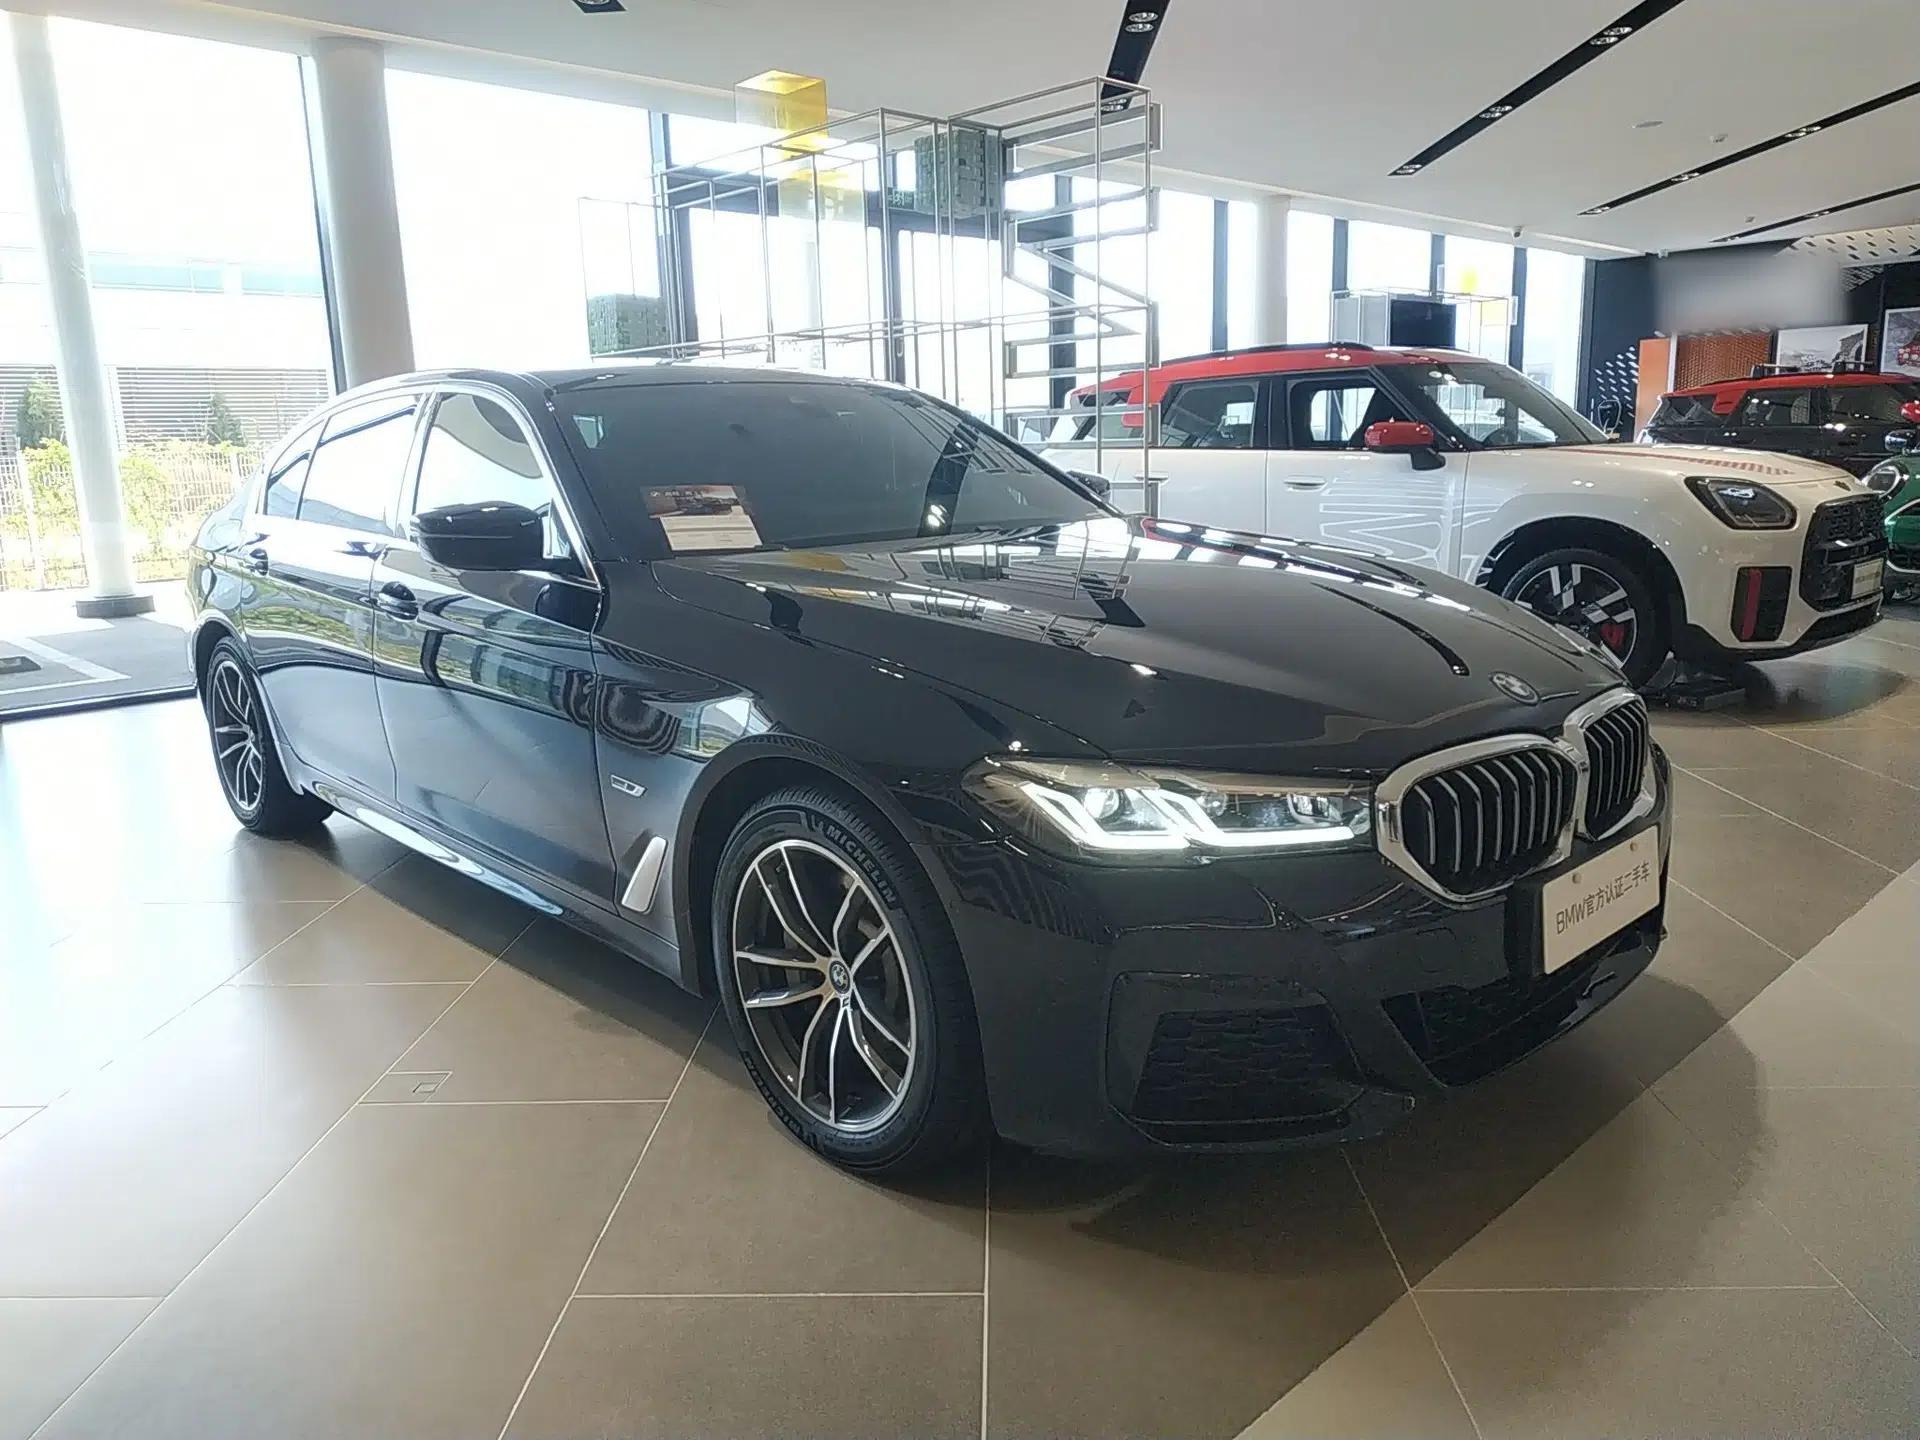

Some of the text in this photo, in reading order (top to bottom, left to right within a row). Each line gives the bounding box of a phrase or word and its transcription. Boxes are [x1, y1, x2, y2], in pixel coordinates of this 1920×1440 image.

[827, 824, 896, 903] MICHELIN
[1556, 861, 1650, 934] BMW官方认证二手车
